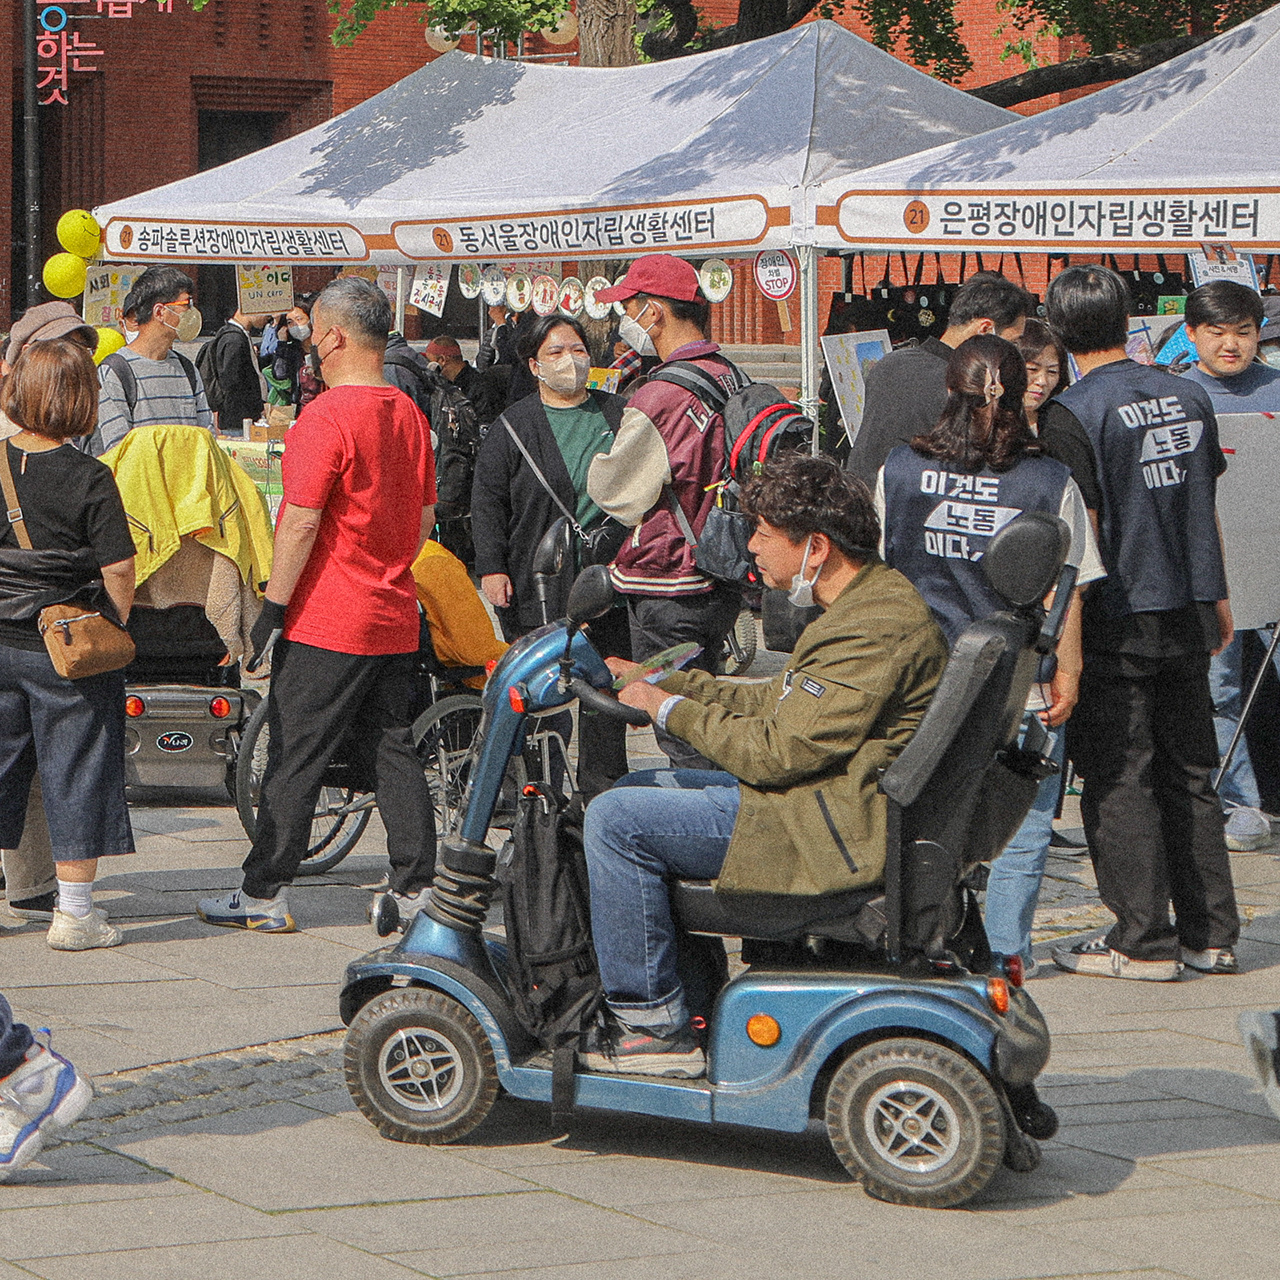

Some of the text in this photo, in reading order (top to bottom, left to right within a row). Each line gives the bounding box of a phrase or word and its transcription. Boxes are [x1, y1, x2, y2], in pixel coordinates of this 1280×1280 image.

[36, 30, 105, 71] 하는
[36, 66, 69, 105] 것
[458, 207, 717, 253] 동서울장애인자립생활센터
[909, 208, 925, 224] 21
[939, 199, 1260, 238] 은평장애인자립생활센터
[137, 226, 351, 256] 송파솔루션장애인자립생활센터
[436, 233, 450, 247] 21
[759, 255, 785, 269] 장애인
[764, 277, 789, 291] STOP
[1152, 425, 1191, 453] 노동
[946, 504, 996, 533] 노동
